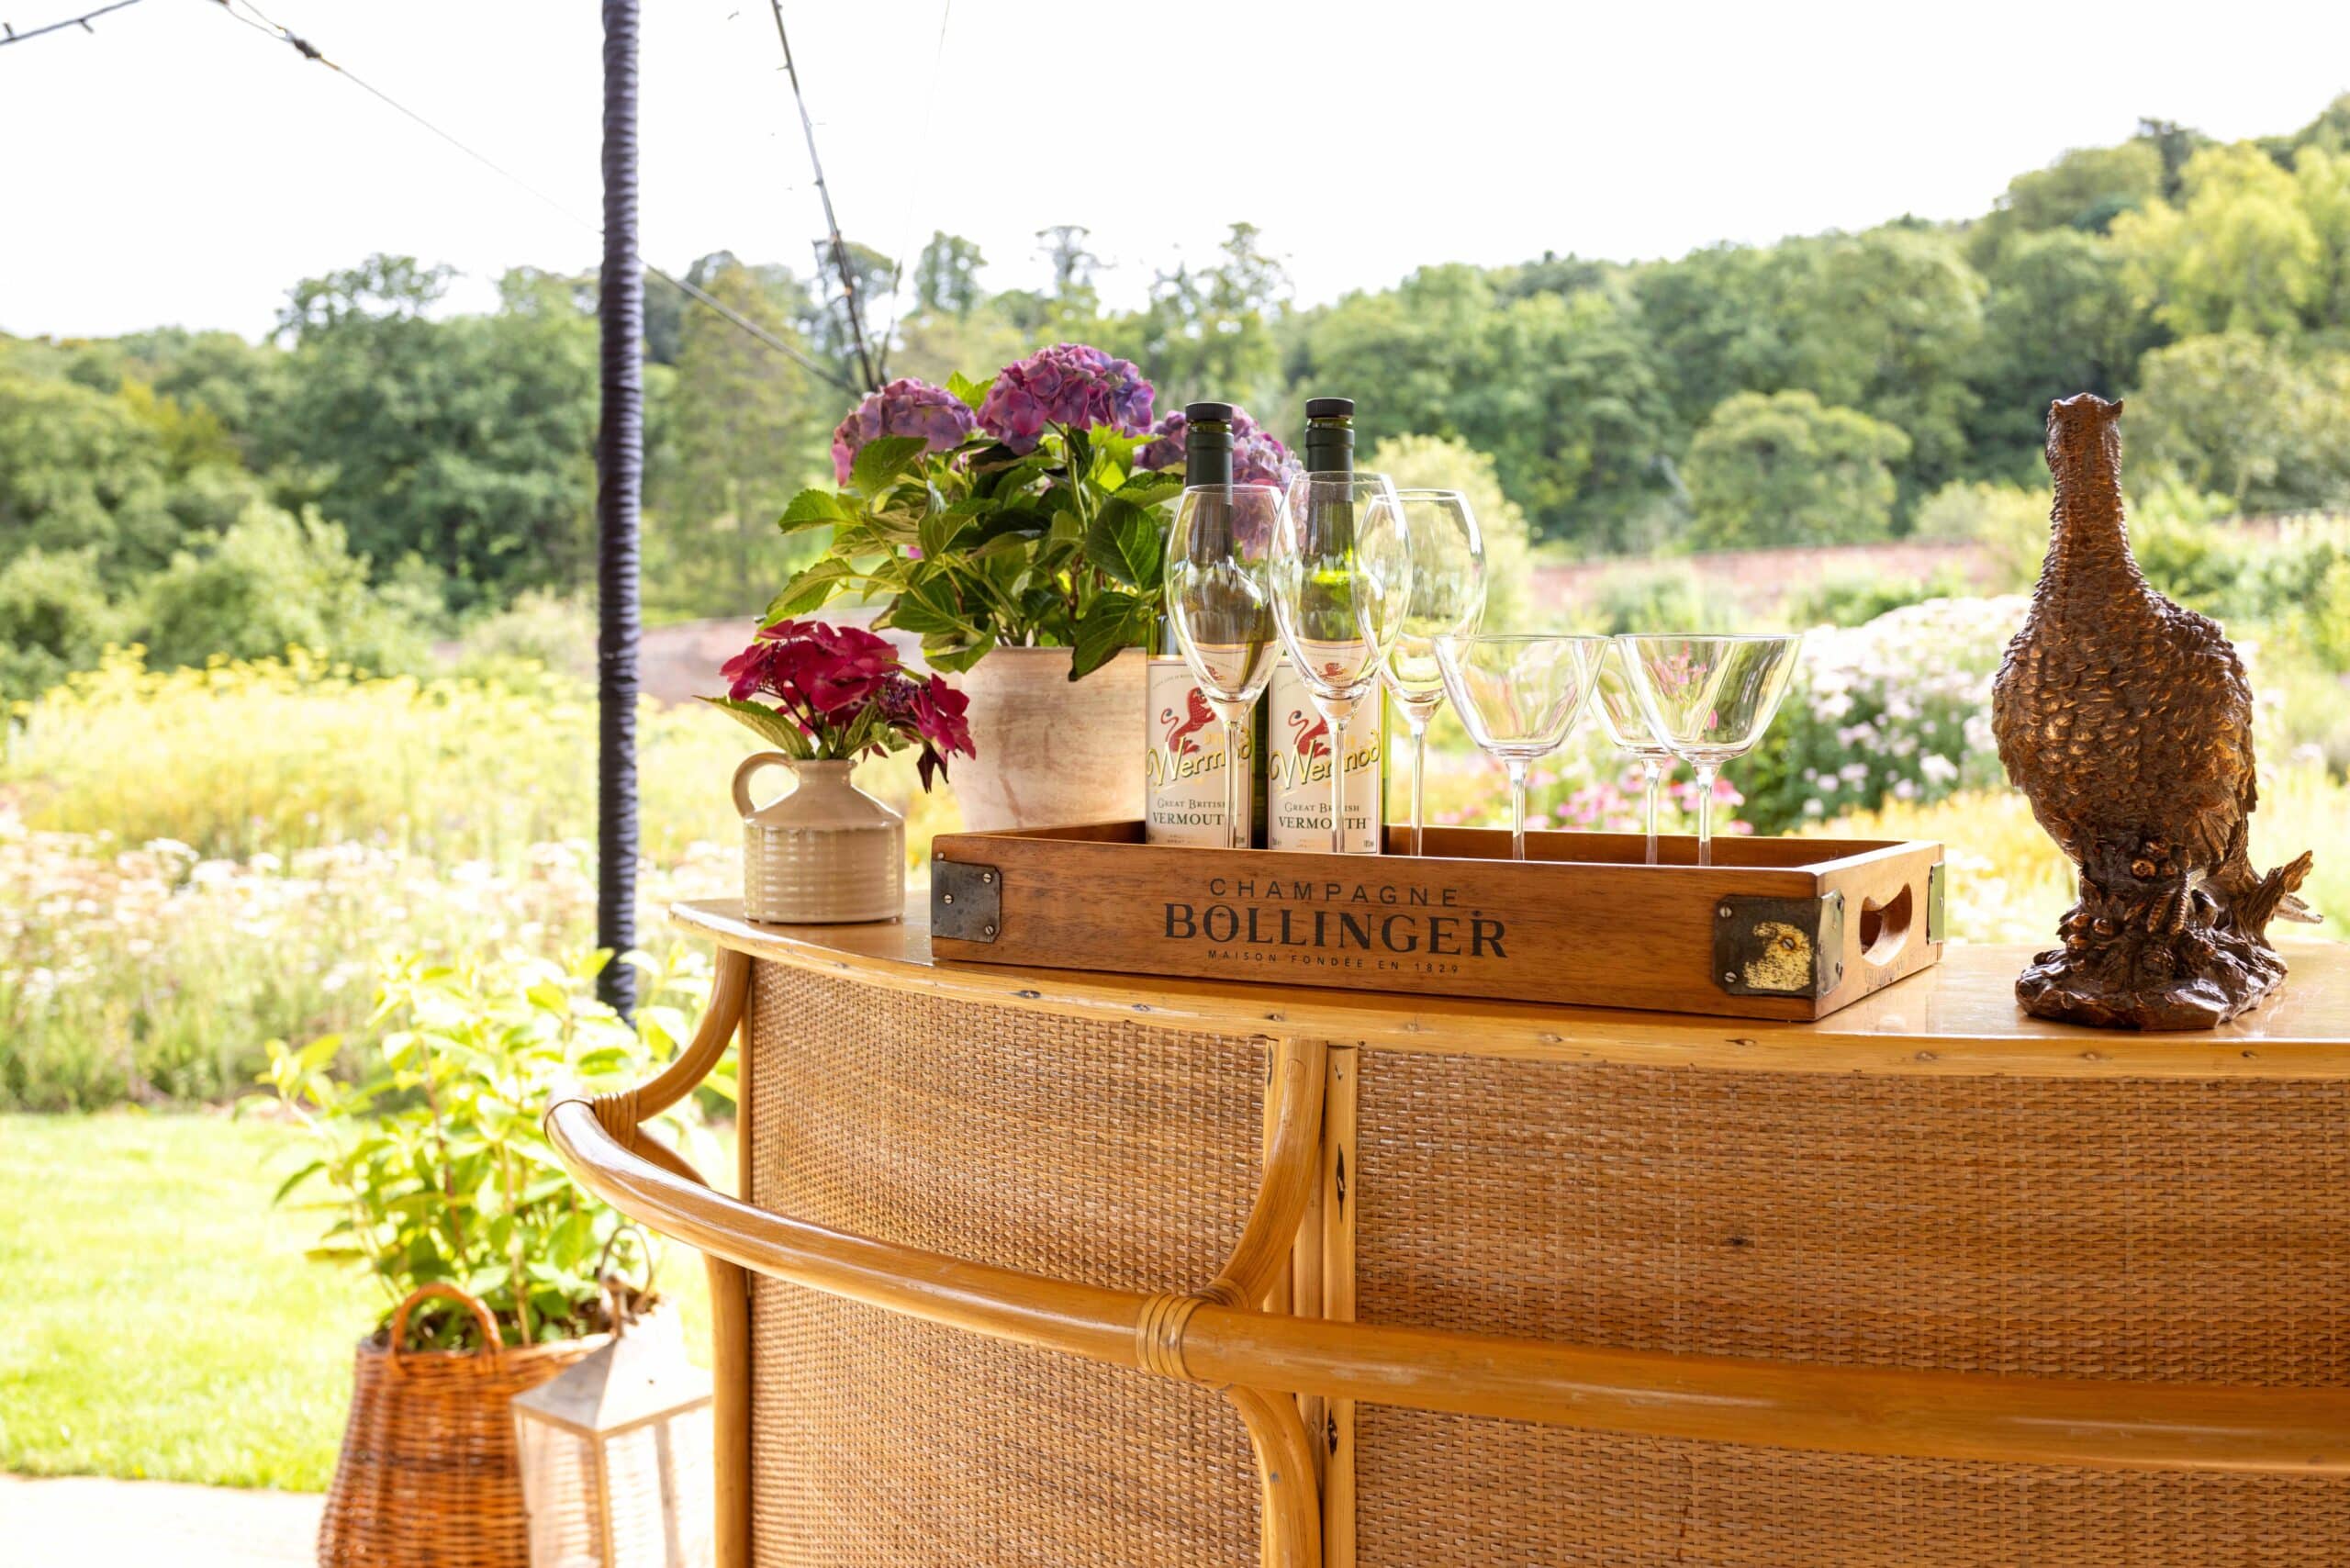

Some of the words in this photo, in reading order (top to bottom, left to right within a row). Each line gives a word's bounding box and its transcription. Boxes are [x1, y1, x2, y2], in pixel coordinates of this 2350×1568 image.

[1147, 727, 1252, 787] Wermd
[1153, 812, 1225, 825] VERMOUT
[1279, 816, 1367, 830] VERMOTH
[1209, 878, 1459, 907] CHAMPAGNE
[1163, 902, 1508, 958] BOLLINGER
[1207, 950, 1278, 963] MAISON
[1378, 960, 1400, 970] EN
[1414, 963, 1460, 973] 1829
